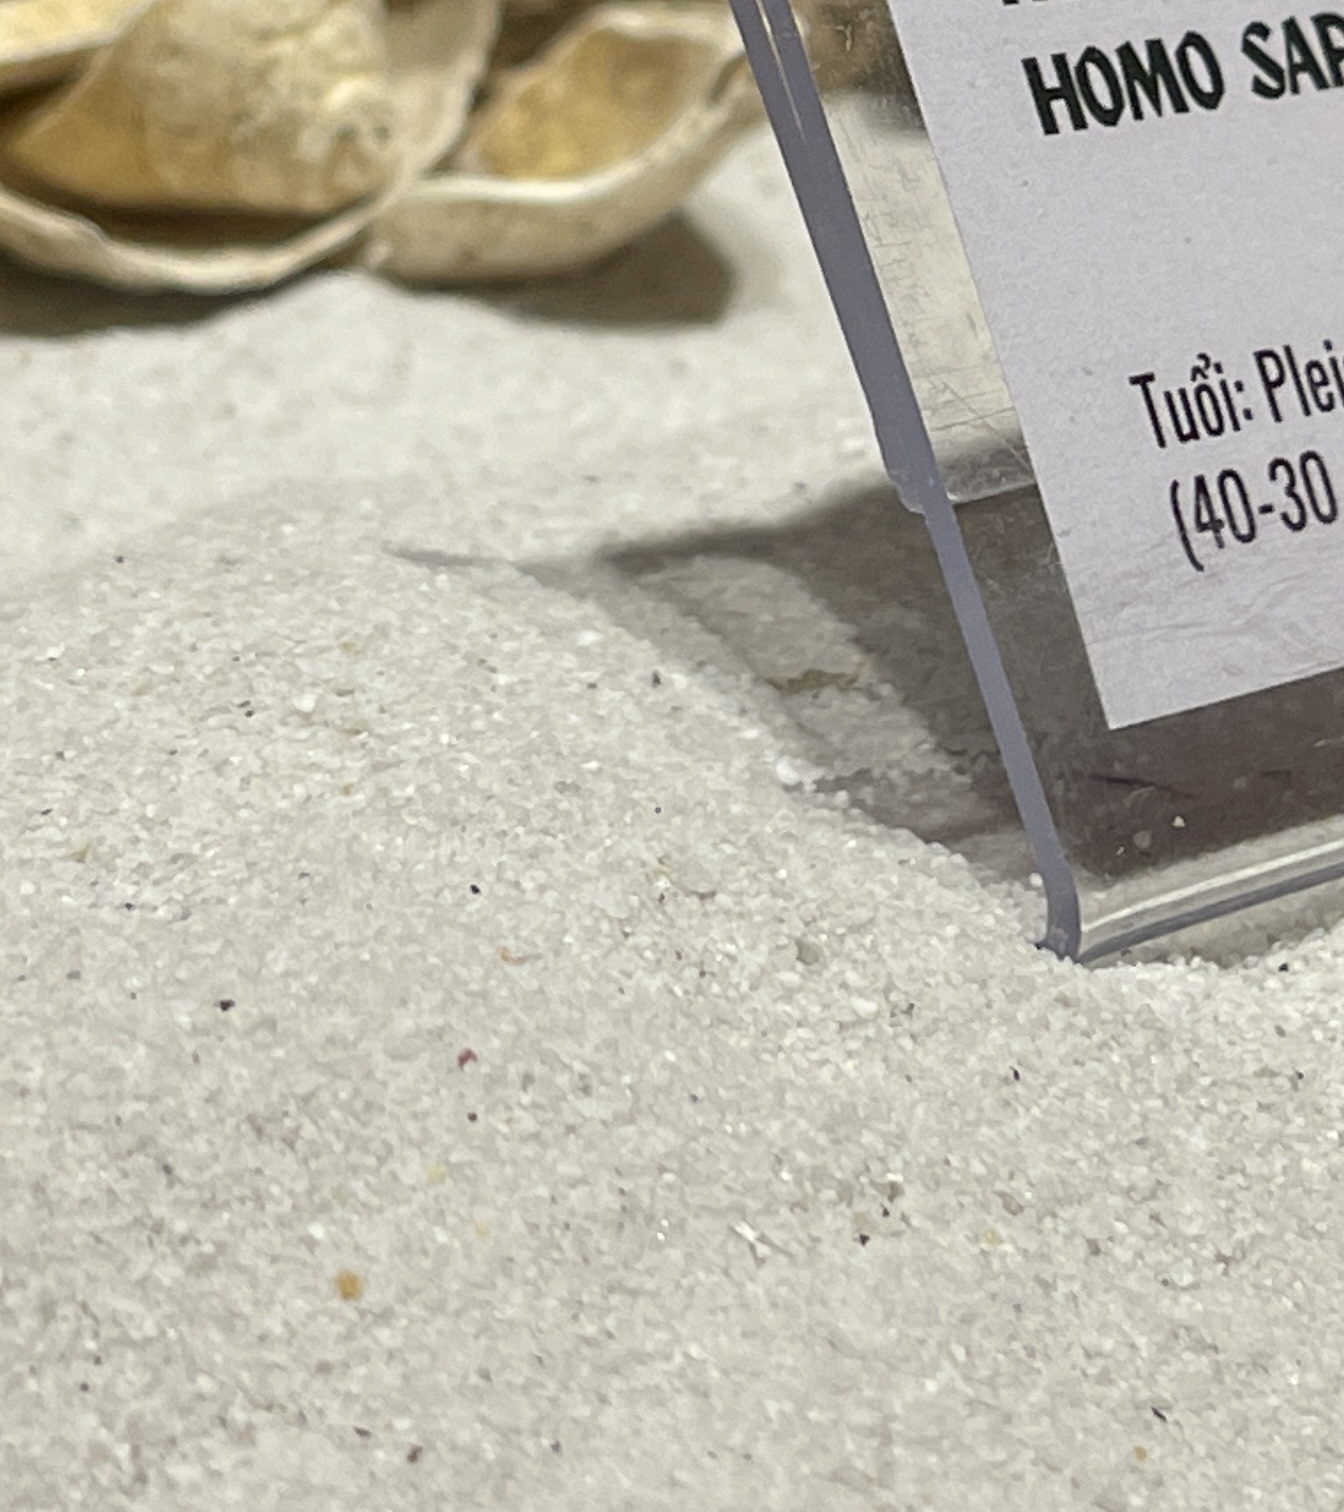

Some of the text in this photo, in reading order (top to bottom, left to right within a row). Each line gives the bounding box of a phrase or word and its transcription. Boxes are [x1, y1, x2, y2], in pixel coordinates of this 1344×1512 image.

[1020, 30, 1225, 136] HOMO
[1129, 353, 1254, 449] Tuổi:
[1168, 450, 1340, 572] (40-30
